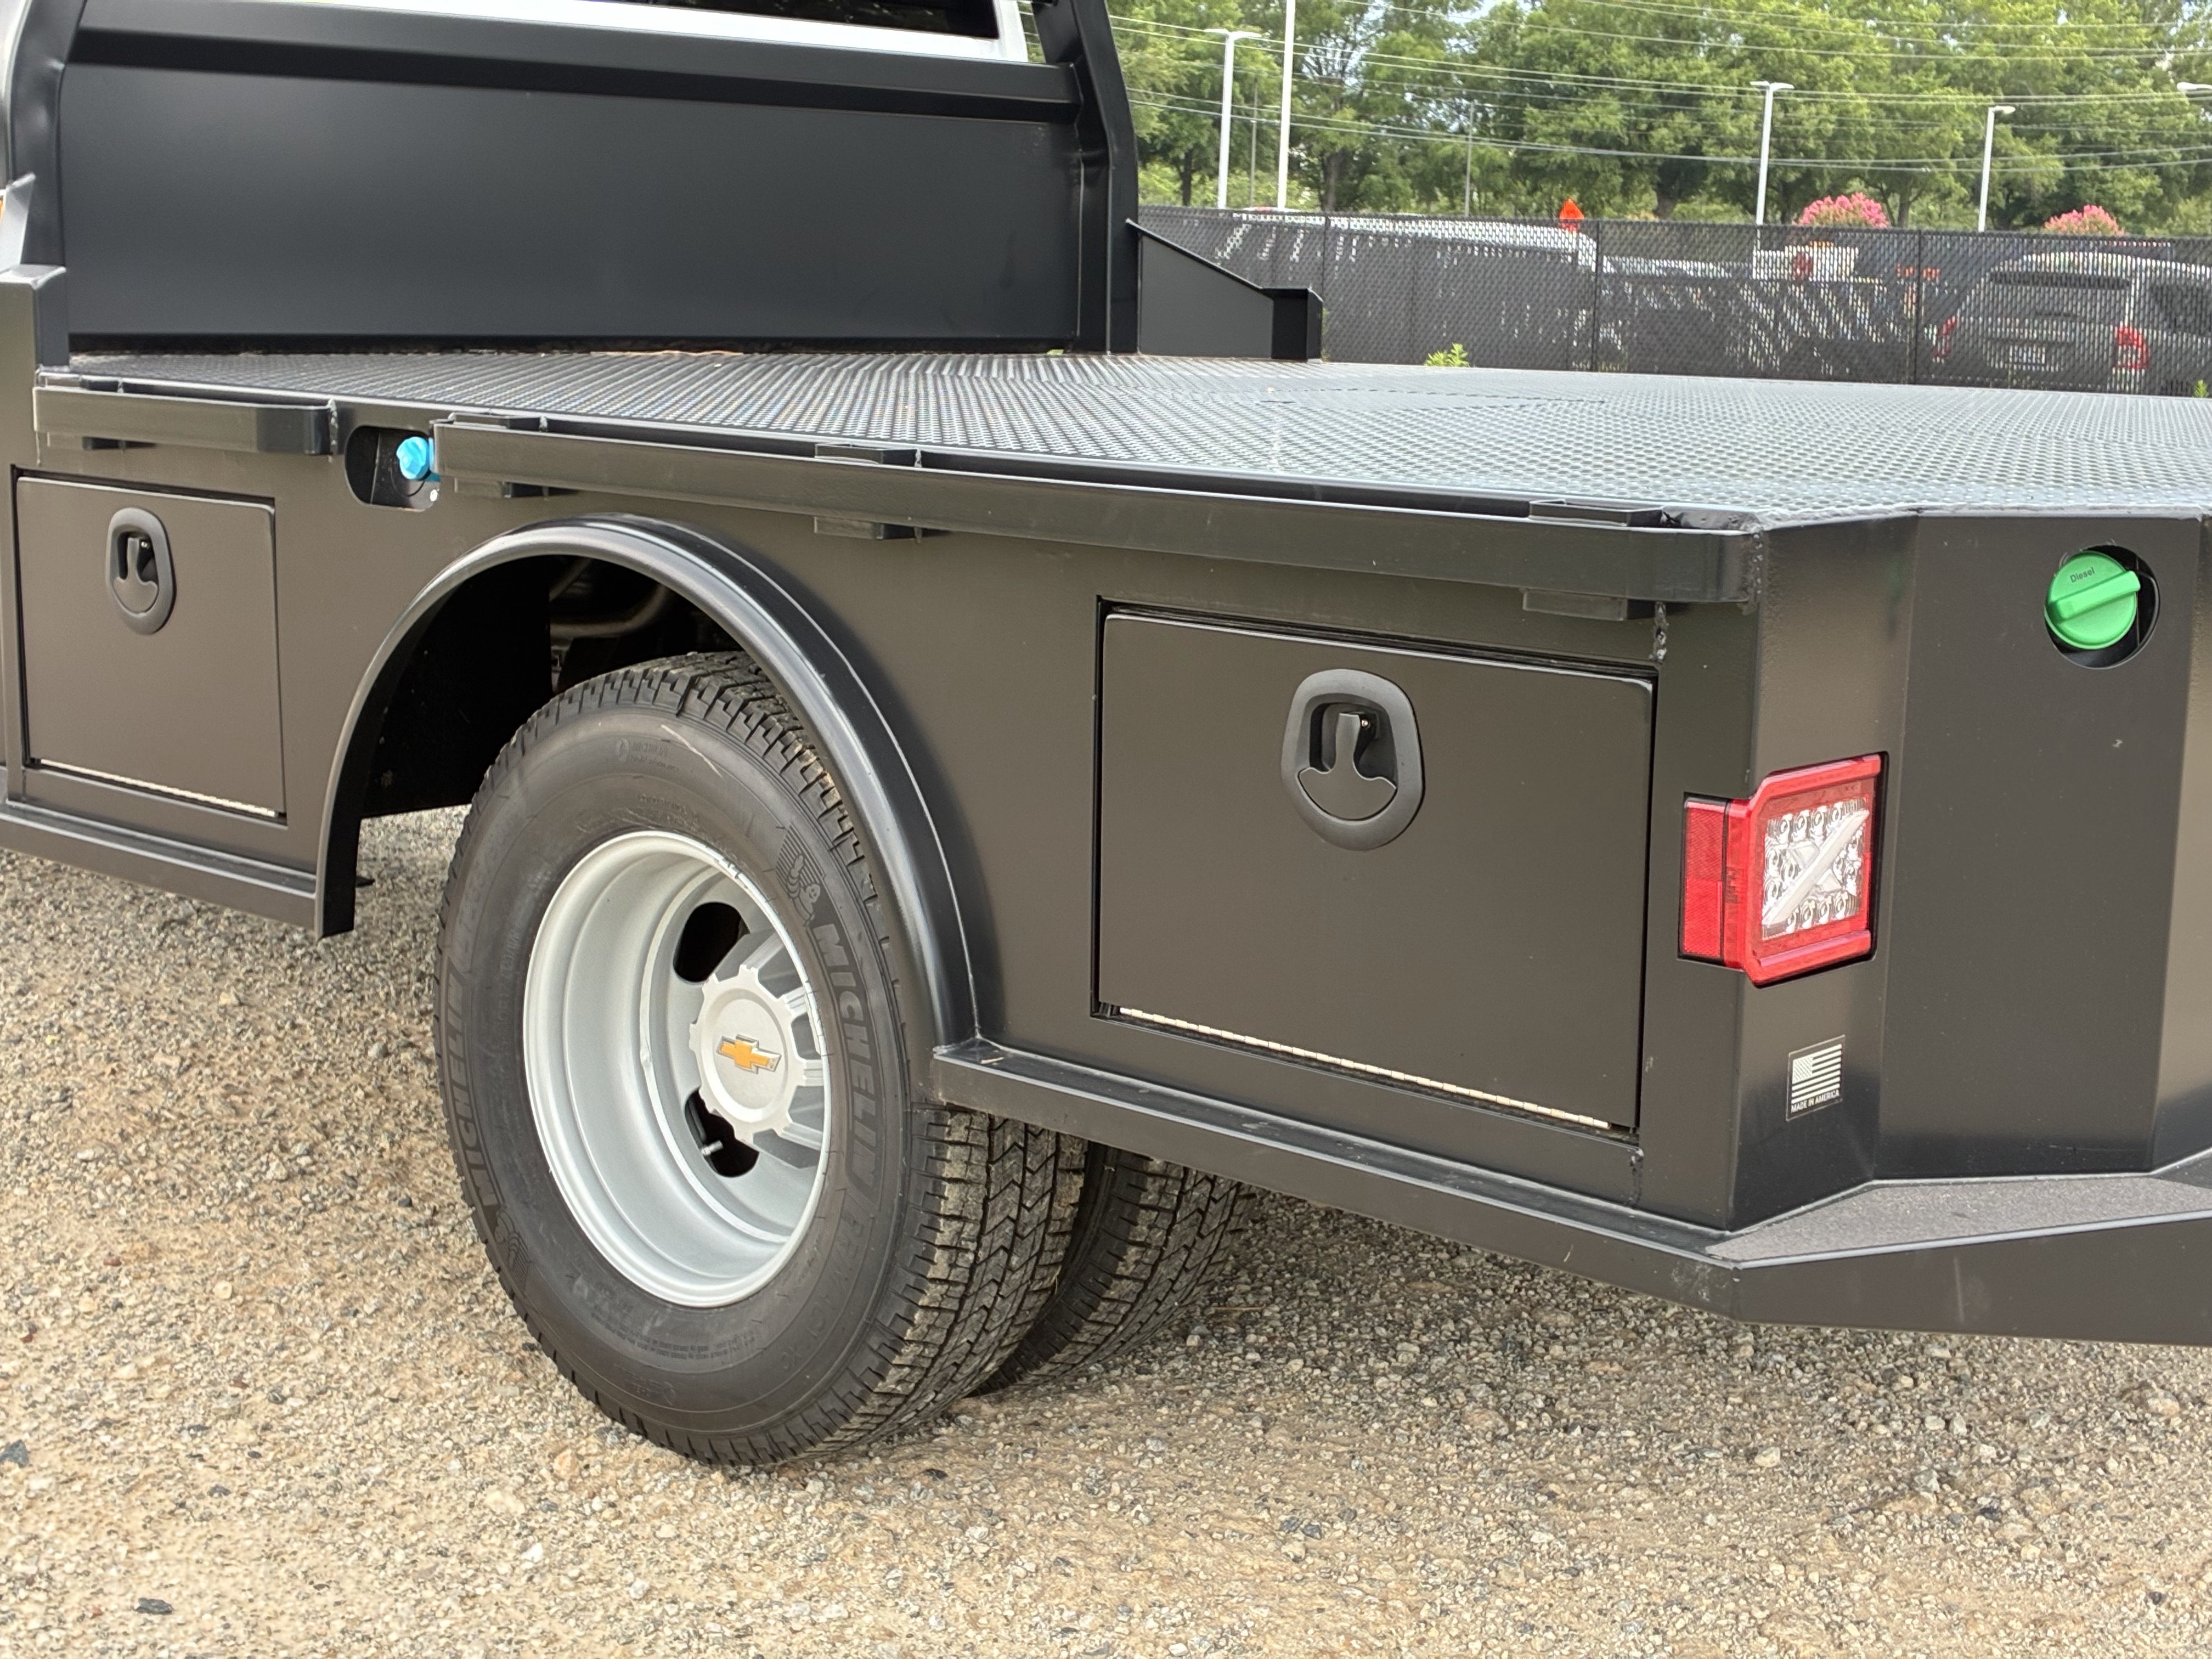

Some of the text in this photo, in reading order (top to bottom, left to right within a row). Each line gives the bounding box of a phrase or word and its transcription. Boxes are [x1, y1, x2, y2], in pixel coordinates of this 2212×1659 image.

[2070, 567, 2095, 583] Diesel
[447, 970, 498, 1206] MICHELIN
[817, 924, 876, 1186] MICHELIN
[1791, 1089, 1839, 1113] MADE IN AMERICA
